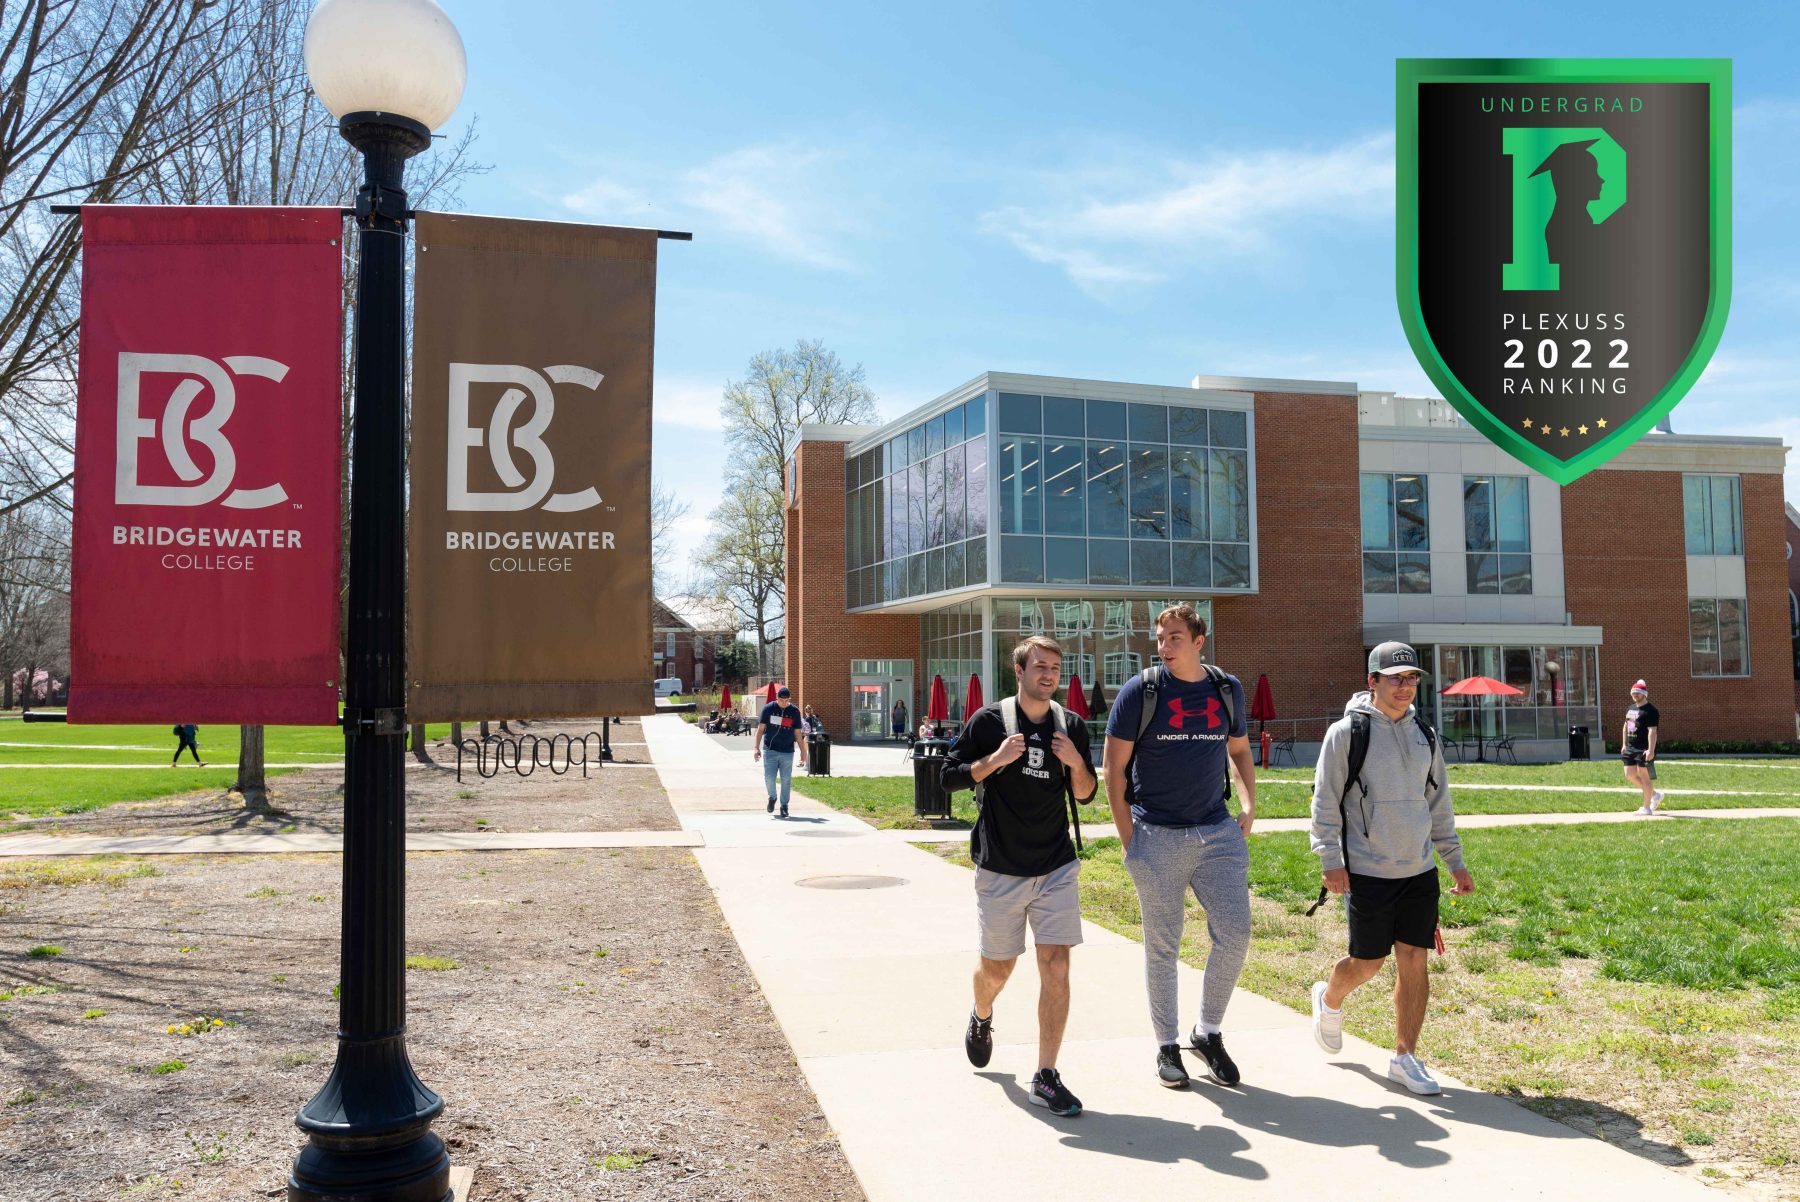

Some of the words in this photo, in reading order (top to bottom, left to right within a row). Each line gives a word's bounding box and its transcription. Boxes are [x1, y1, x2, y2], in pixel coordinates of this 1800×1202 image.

[112, 525, 302, 549] BRIDGEWATER
[445, 531, 615, 551] BRIDGEWATER
[161, 554, 254, 571] COLLEGE
[489, 557, 572, 573] COLLEGE
[1028, 746, 1045, 769] B
[1022, 766, 1050, 779] SOCCER
